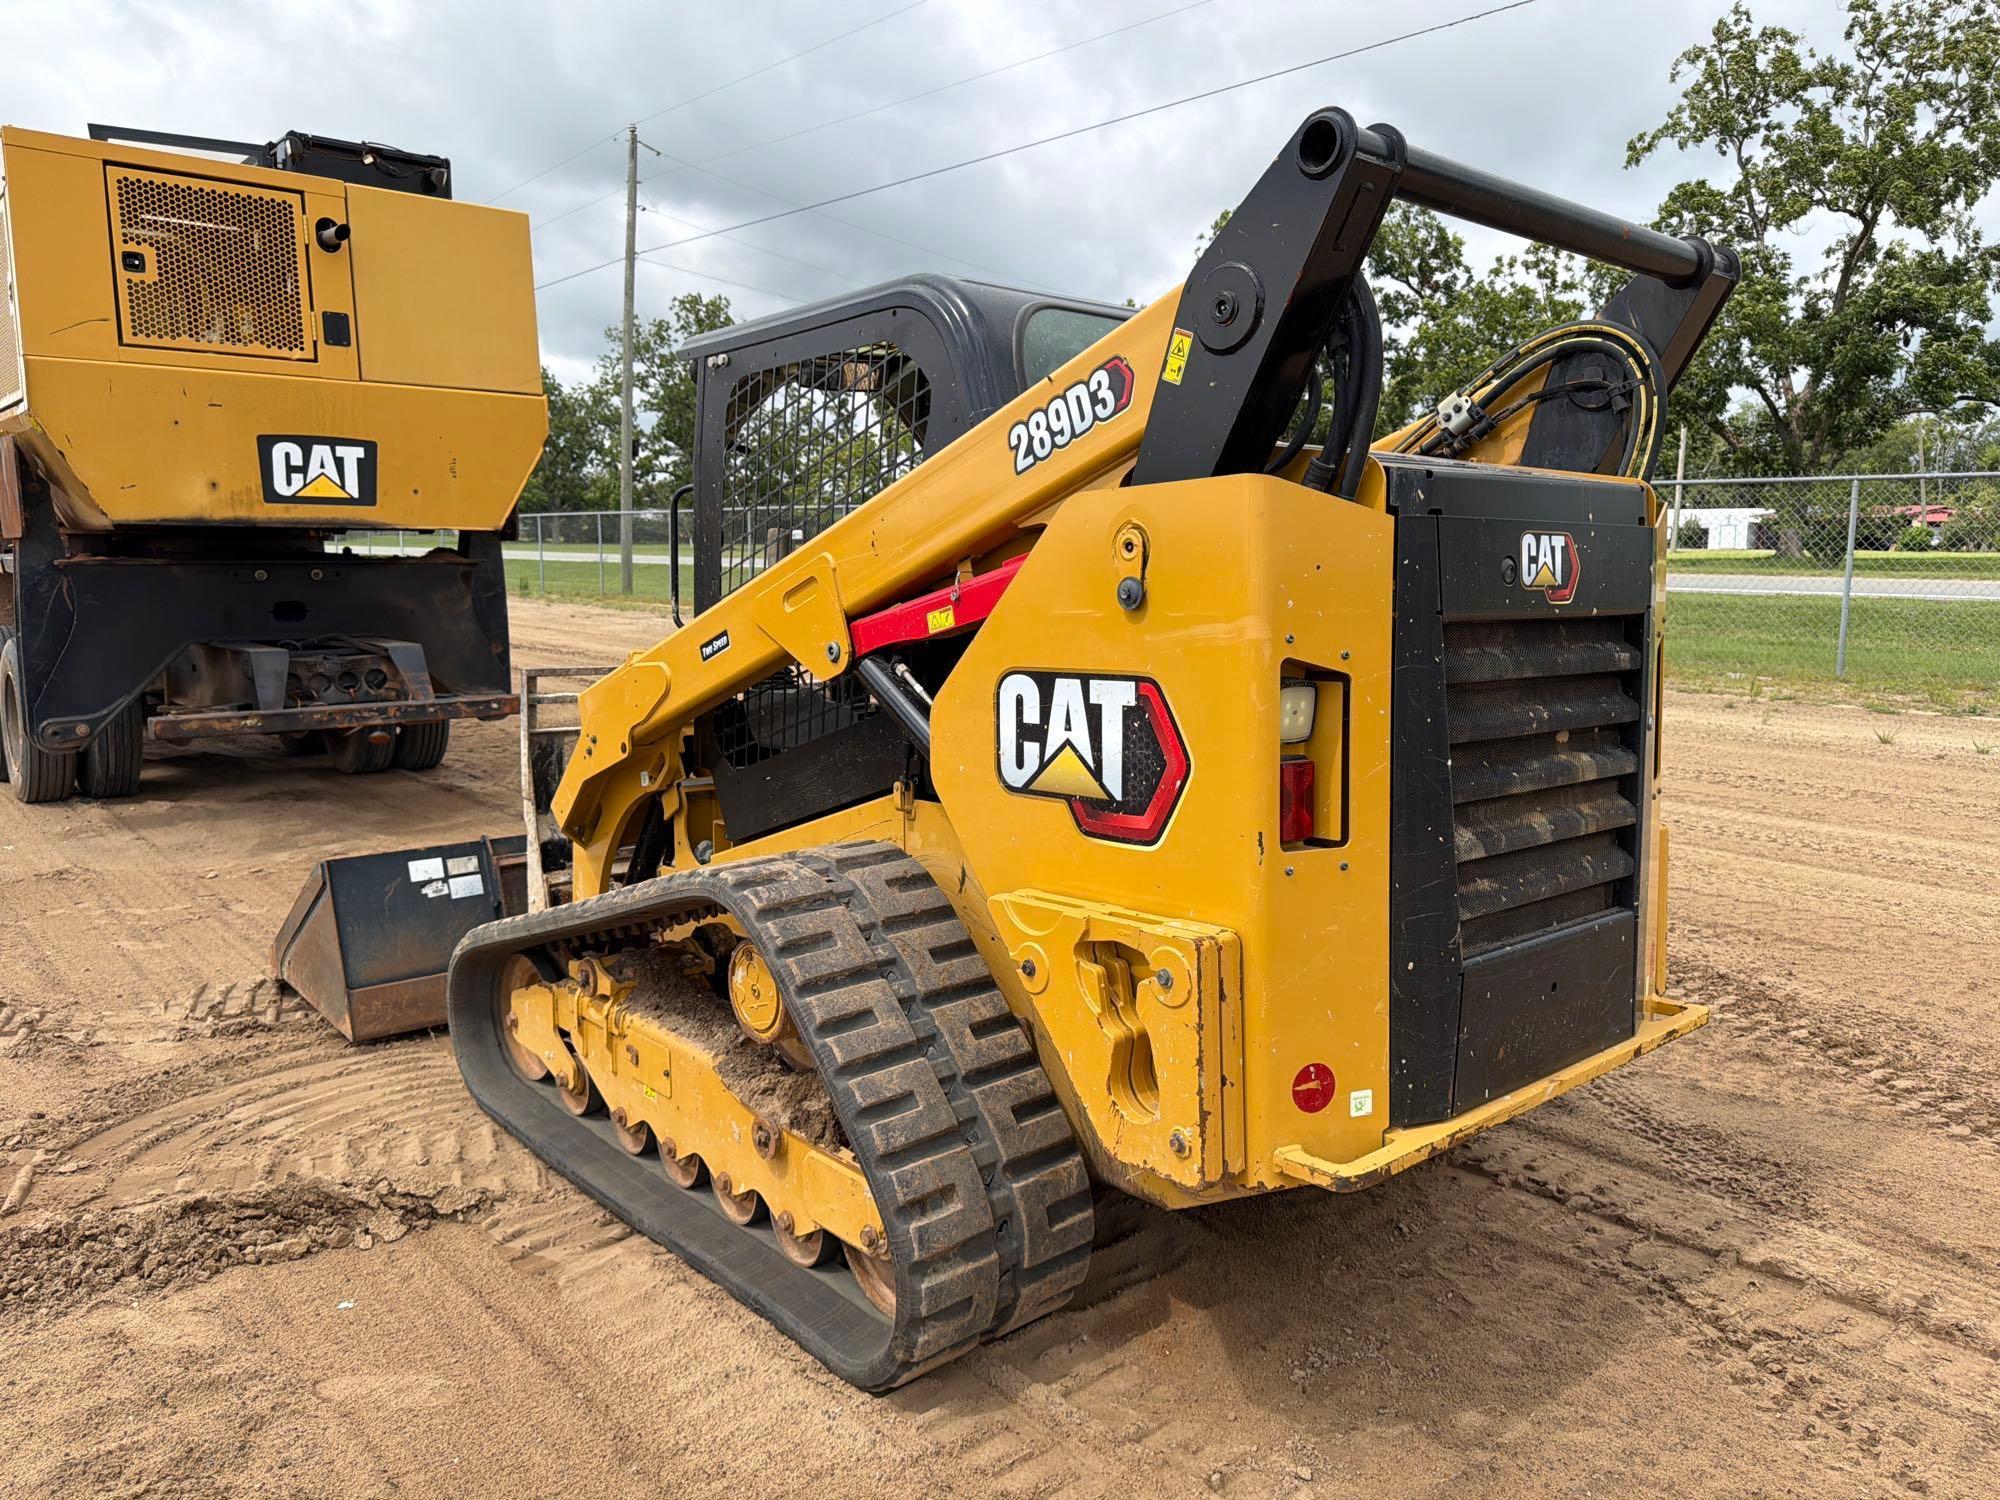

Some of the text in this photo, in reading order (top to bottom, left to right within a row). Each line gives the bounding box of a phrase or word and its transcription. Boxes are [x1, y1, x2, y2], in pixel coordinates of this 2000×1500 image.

[1009, 369, 1115, 472] 289D3
[271, 441, 365, 499] CAT
[1521, 533, 1566, 586] CAT
[999, 673, 1137, 801] CAT
